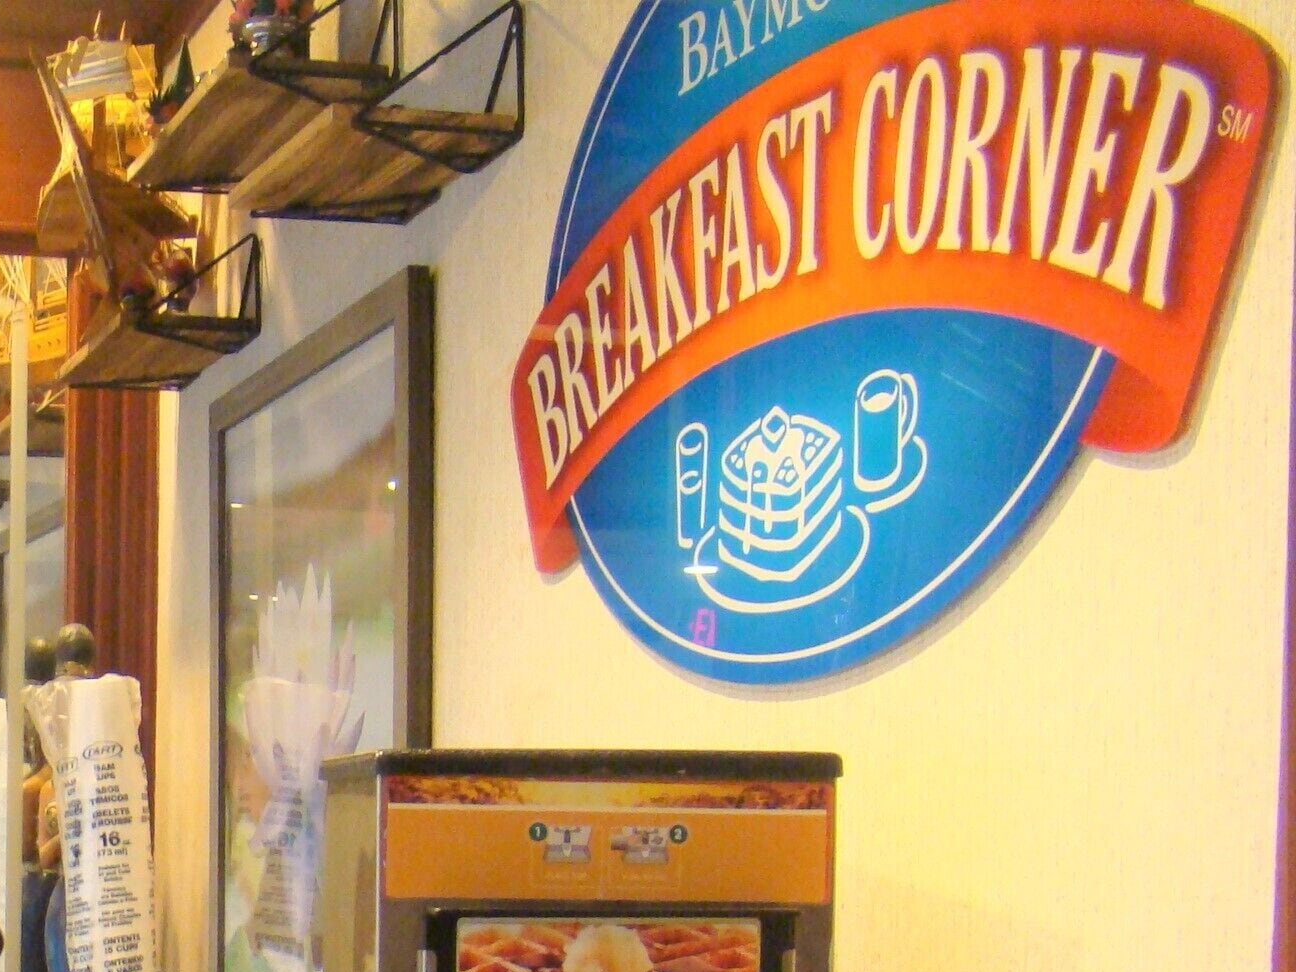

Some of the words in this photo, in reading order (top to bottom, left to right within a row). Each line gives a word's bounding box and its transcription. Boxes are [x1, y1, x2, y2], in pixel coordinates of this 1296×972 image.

[678, 0, 829, 97] BAYM
[527, 91, 832, 490] BREAKFAST
[853, 47, 1212, 311] CORNER
[1217, 104, 1252, 144] SM
[99, 830, 121, 847] 16
